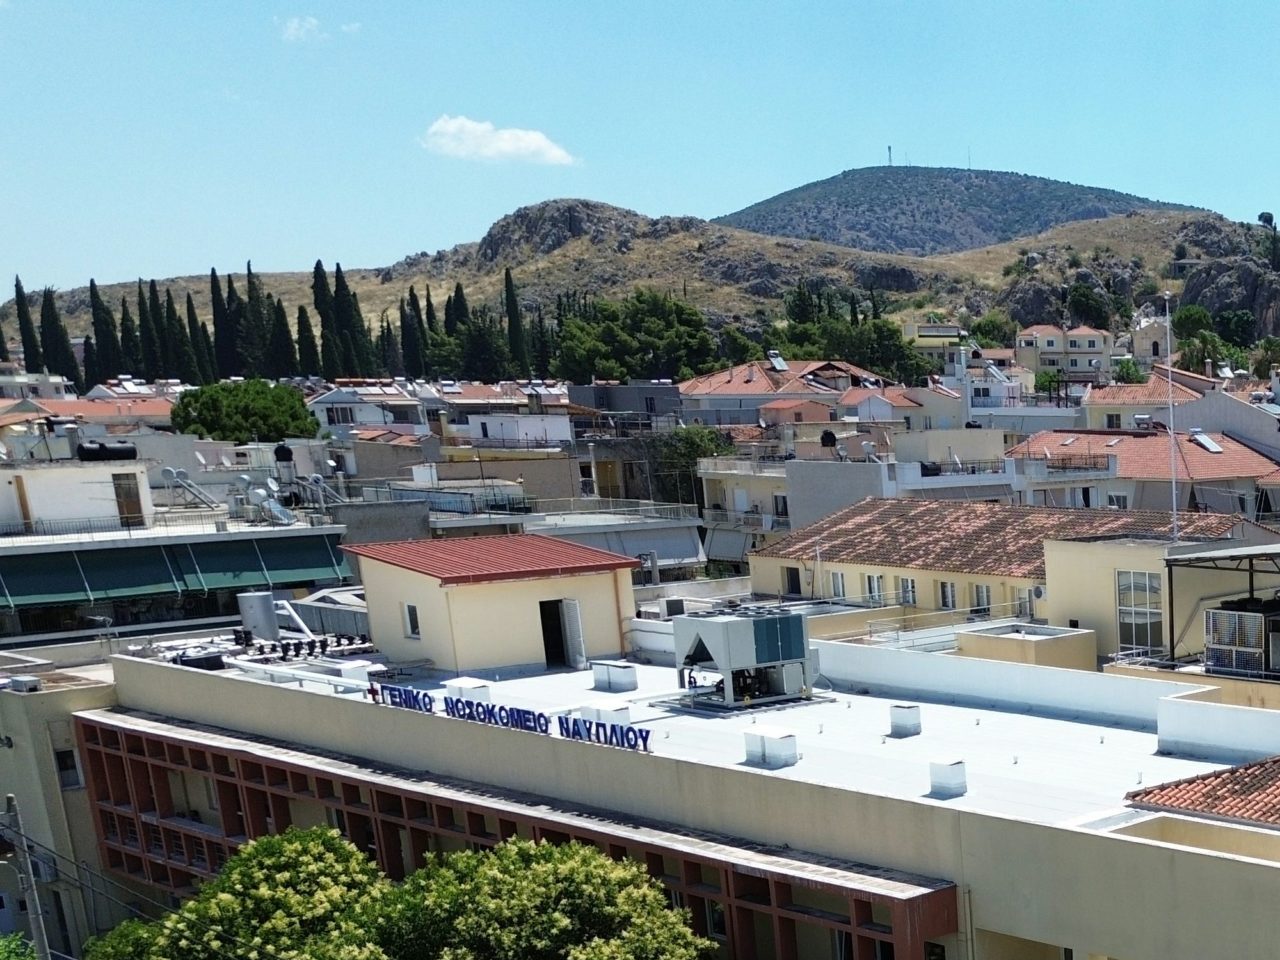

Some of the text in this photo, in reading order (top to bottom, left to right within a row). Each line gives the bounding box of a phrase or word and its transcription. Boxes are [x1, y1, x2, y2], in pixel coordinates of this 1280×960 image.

[381, 683, 652, 752] ΓΕΝΙΚΟ ΝΟΣΟΚΟΜΕΙΟ ΝΑΥΠΛΙΟΥ
